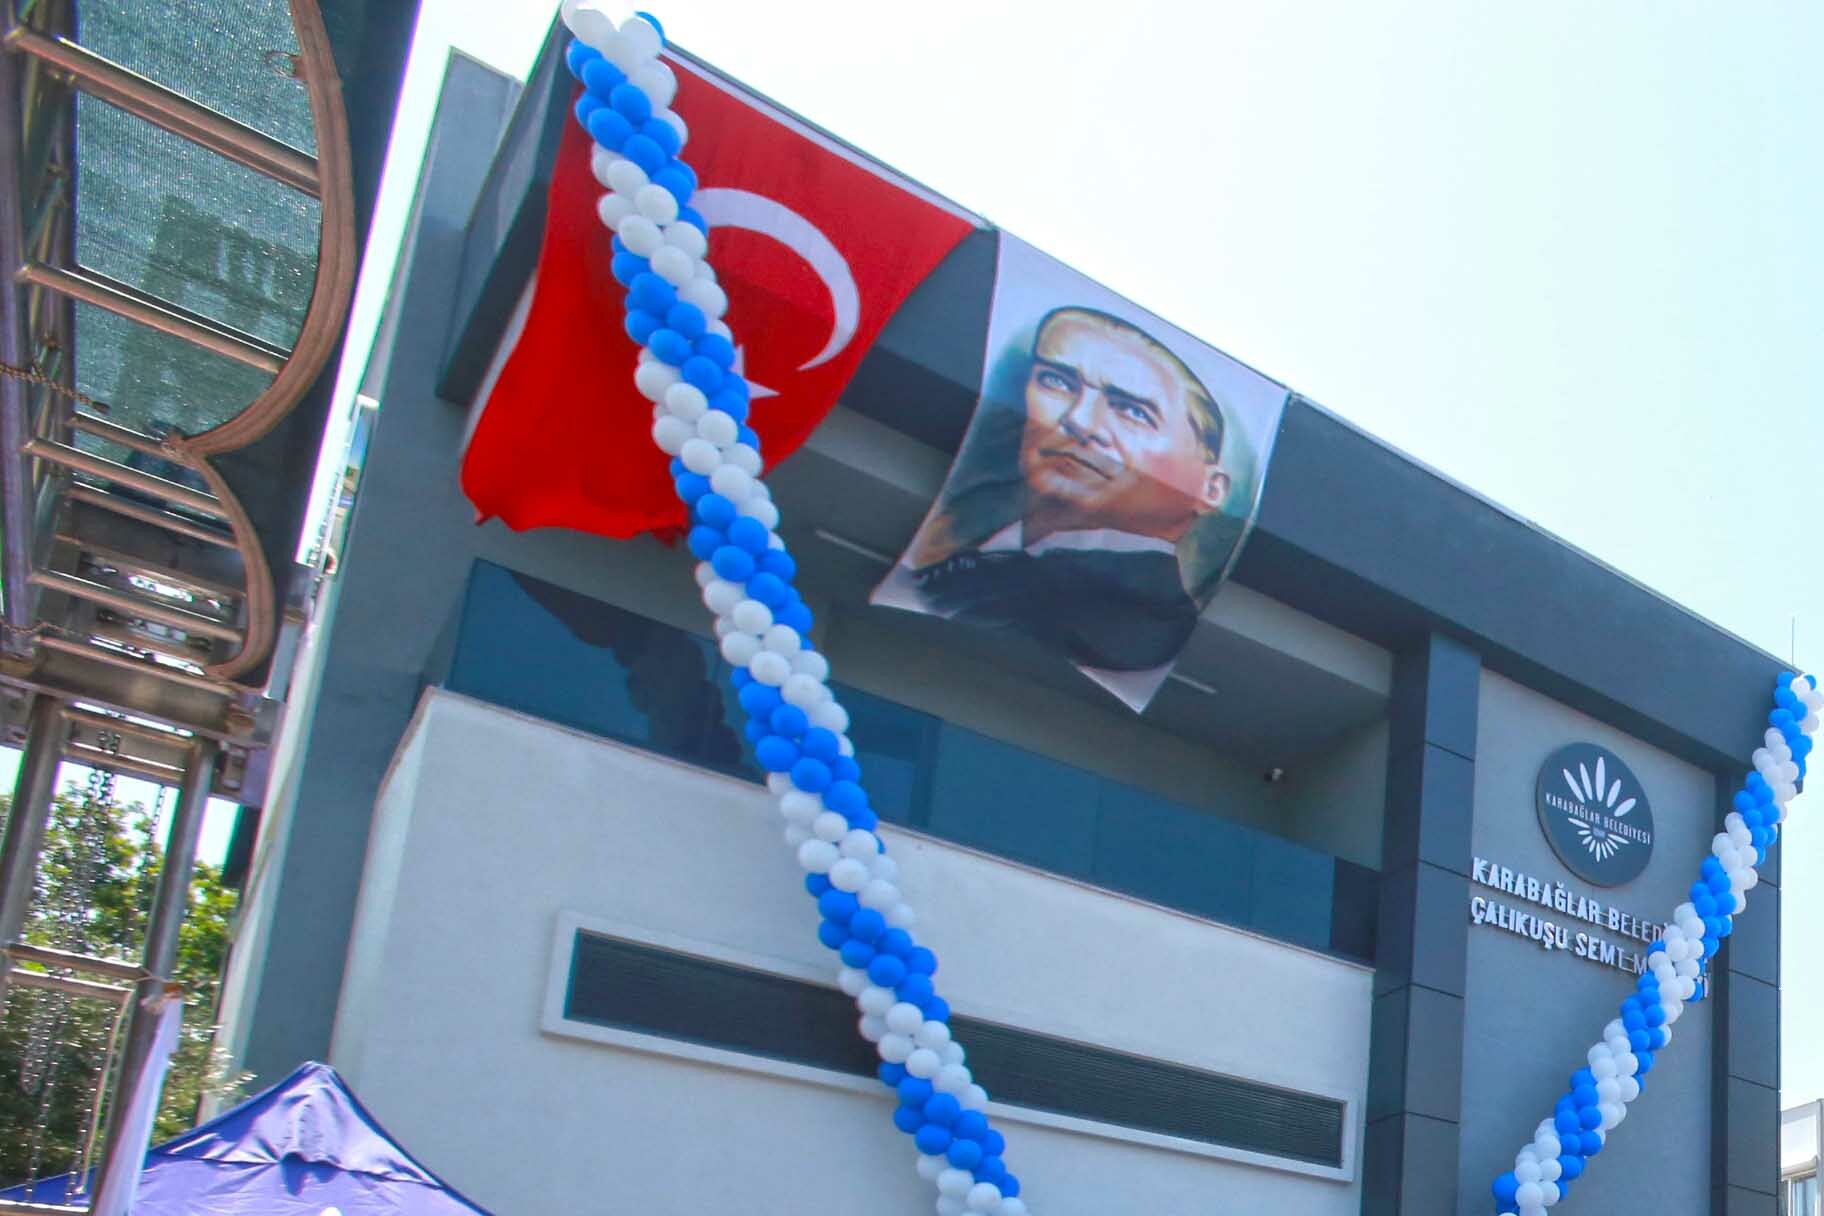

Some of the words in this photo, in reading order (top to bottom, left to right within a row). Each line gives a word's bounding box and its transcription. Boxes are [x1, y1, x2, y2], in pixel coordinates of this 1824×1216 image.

[1470, 896, 1569, 951] ÇALIKUŞU
[1575, 932, 1625, 972] SEMT
[1472, 856, 1602, 925] KARABAĞLAR
[1608, 906, 1669, 944] BELED
